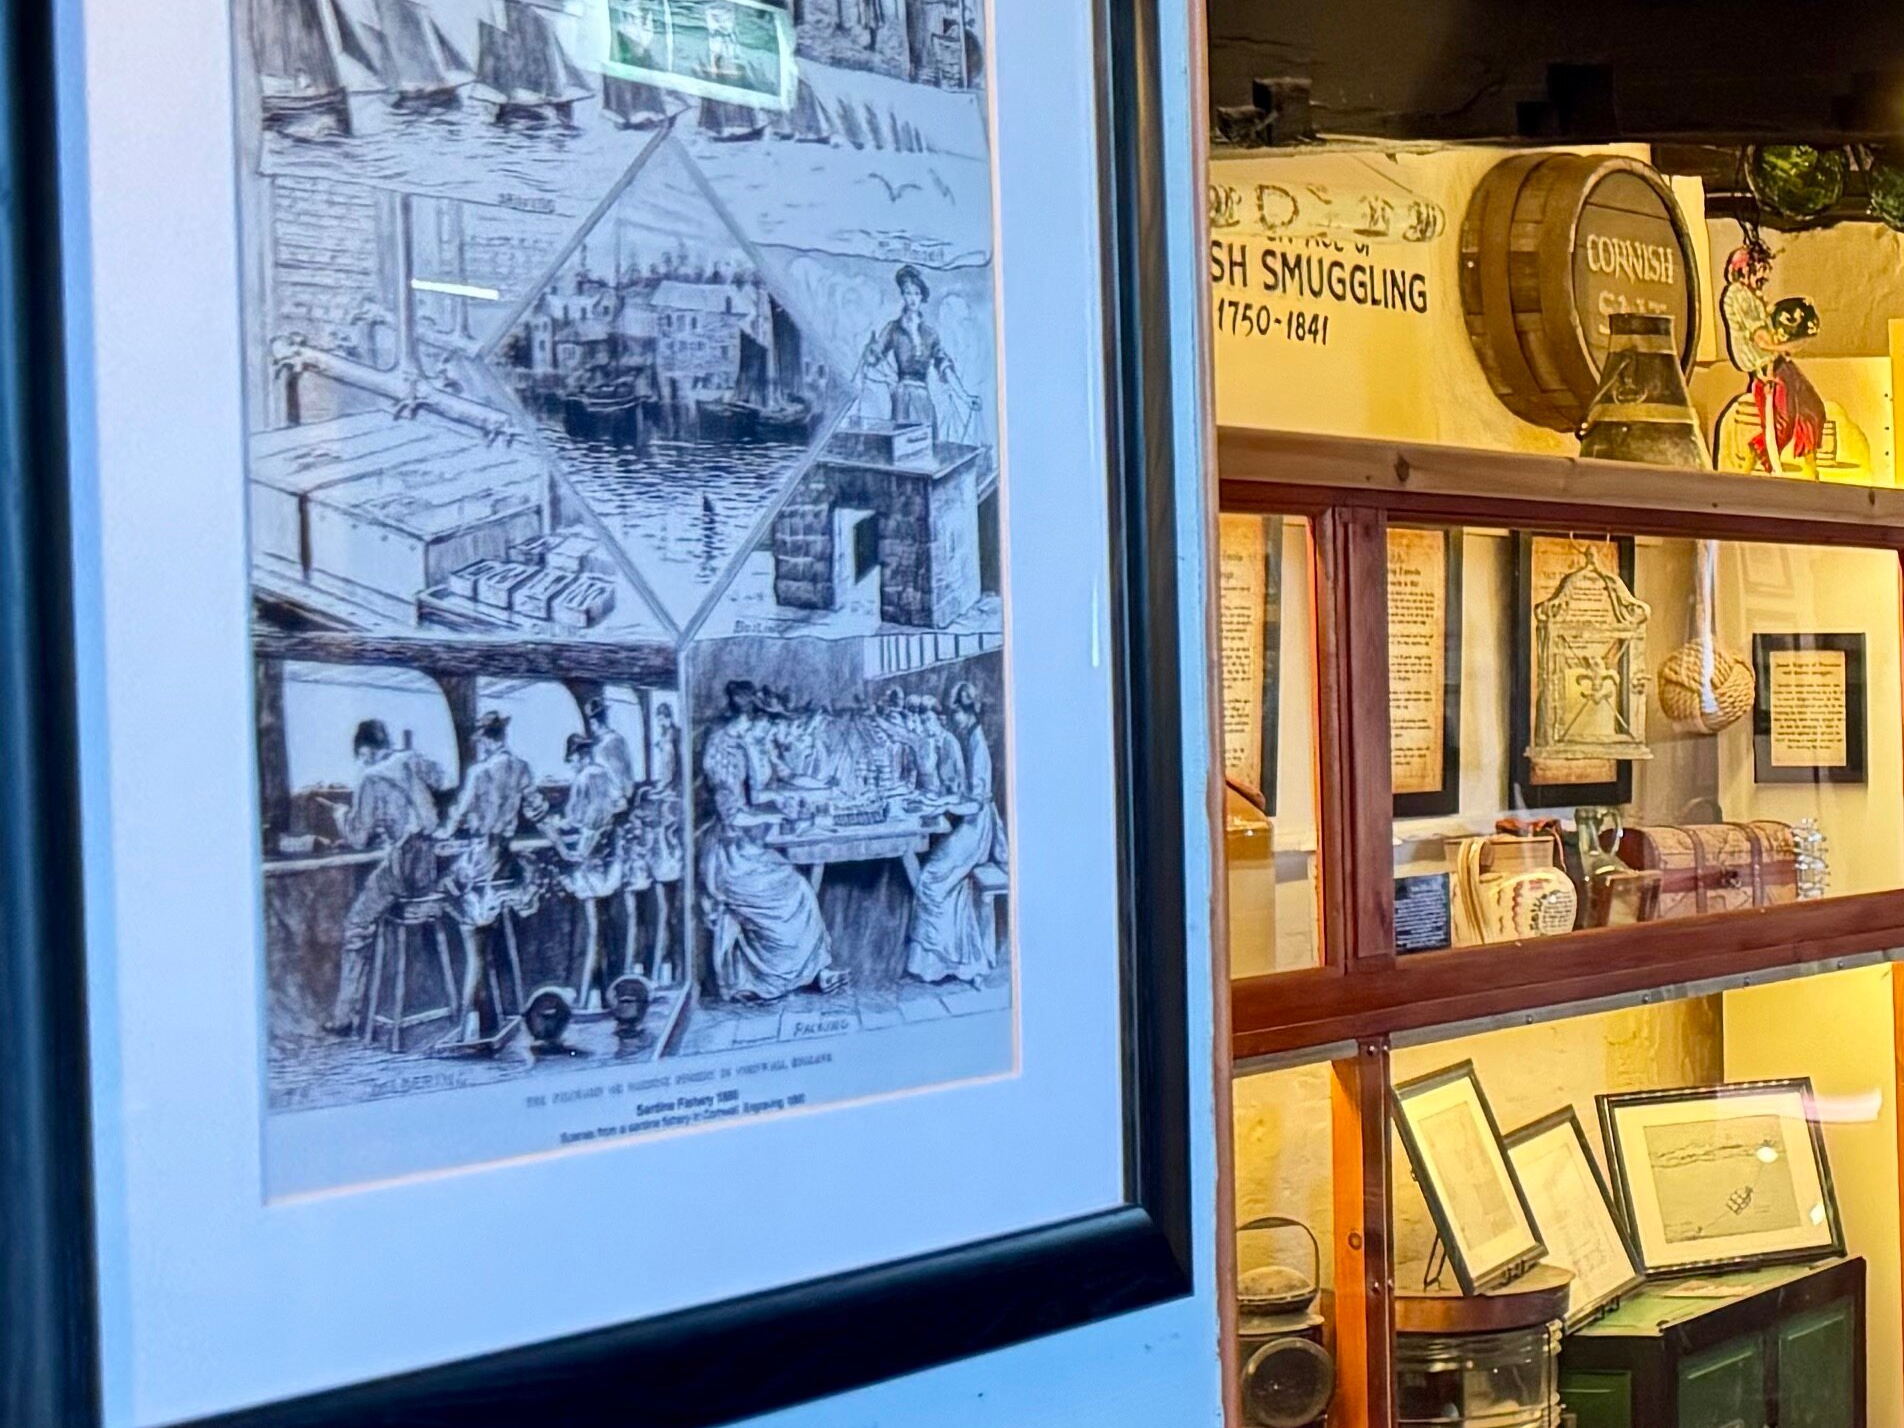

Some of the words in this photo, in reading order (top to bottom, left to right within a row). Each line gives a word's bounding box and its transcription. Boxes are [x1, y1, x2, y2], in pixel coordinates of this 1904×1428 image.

[1260, 248, 1428, 314] SMUGGLING
[1586, 234, 1674, 285] CORNISH
[1217, 297, 1330, 346] 1750-1841
